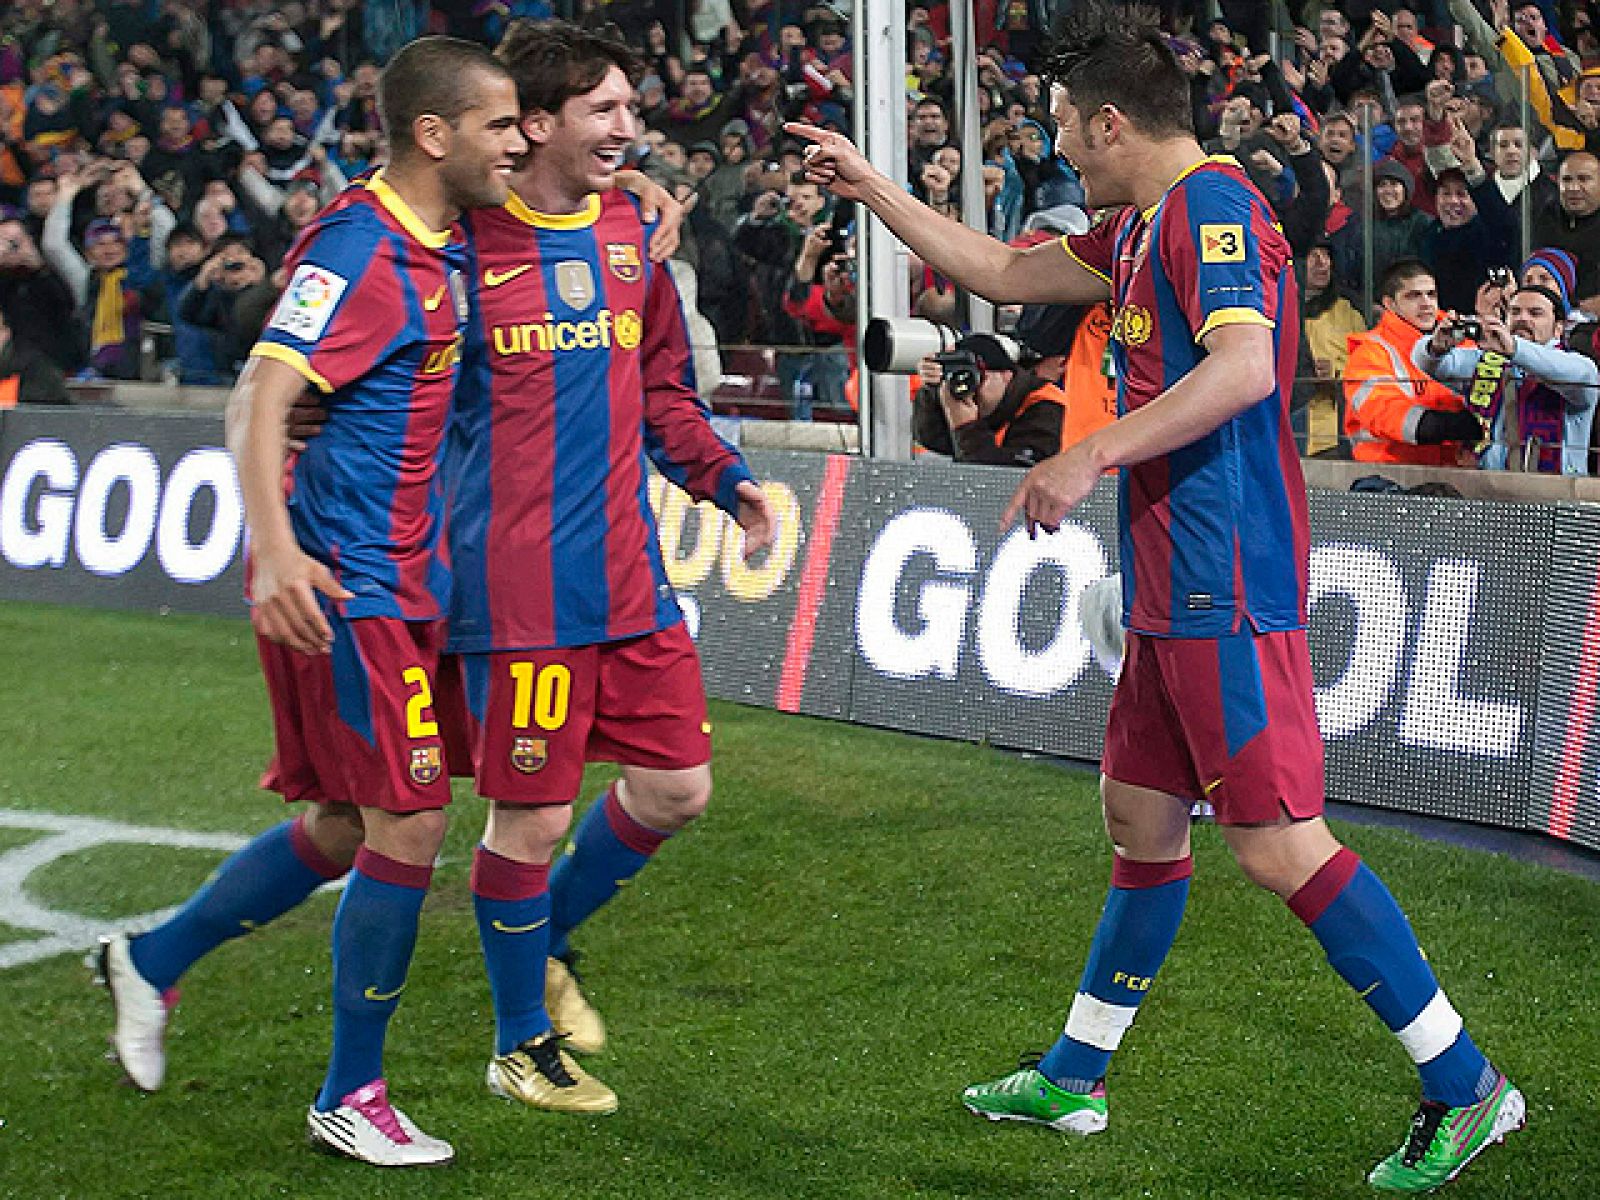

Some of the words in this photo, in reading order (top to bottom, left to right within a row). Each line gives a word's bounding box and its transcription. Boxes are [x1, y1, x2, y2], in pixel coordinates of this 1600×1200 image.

[1219, 231, 1239, 256] 3
[493, 309, 612, 356] unicef
[0, 437, 246, 584] GOO
[402, 666, 439, 739] 2
[509, 661, 571, 731] 10
